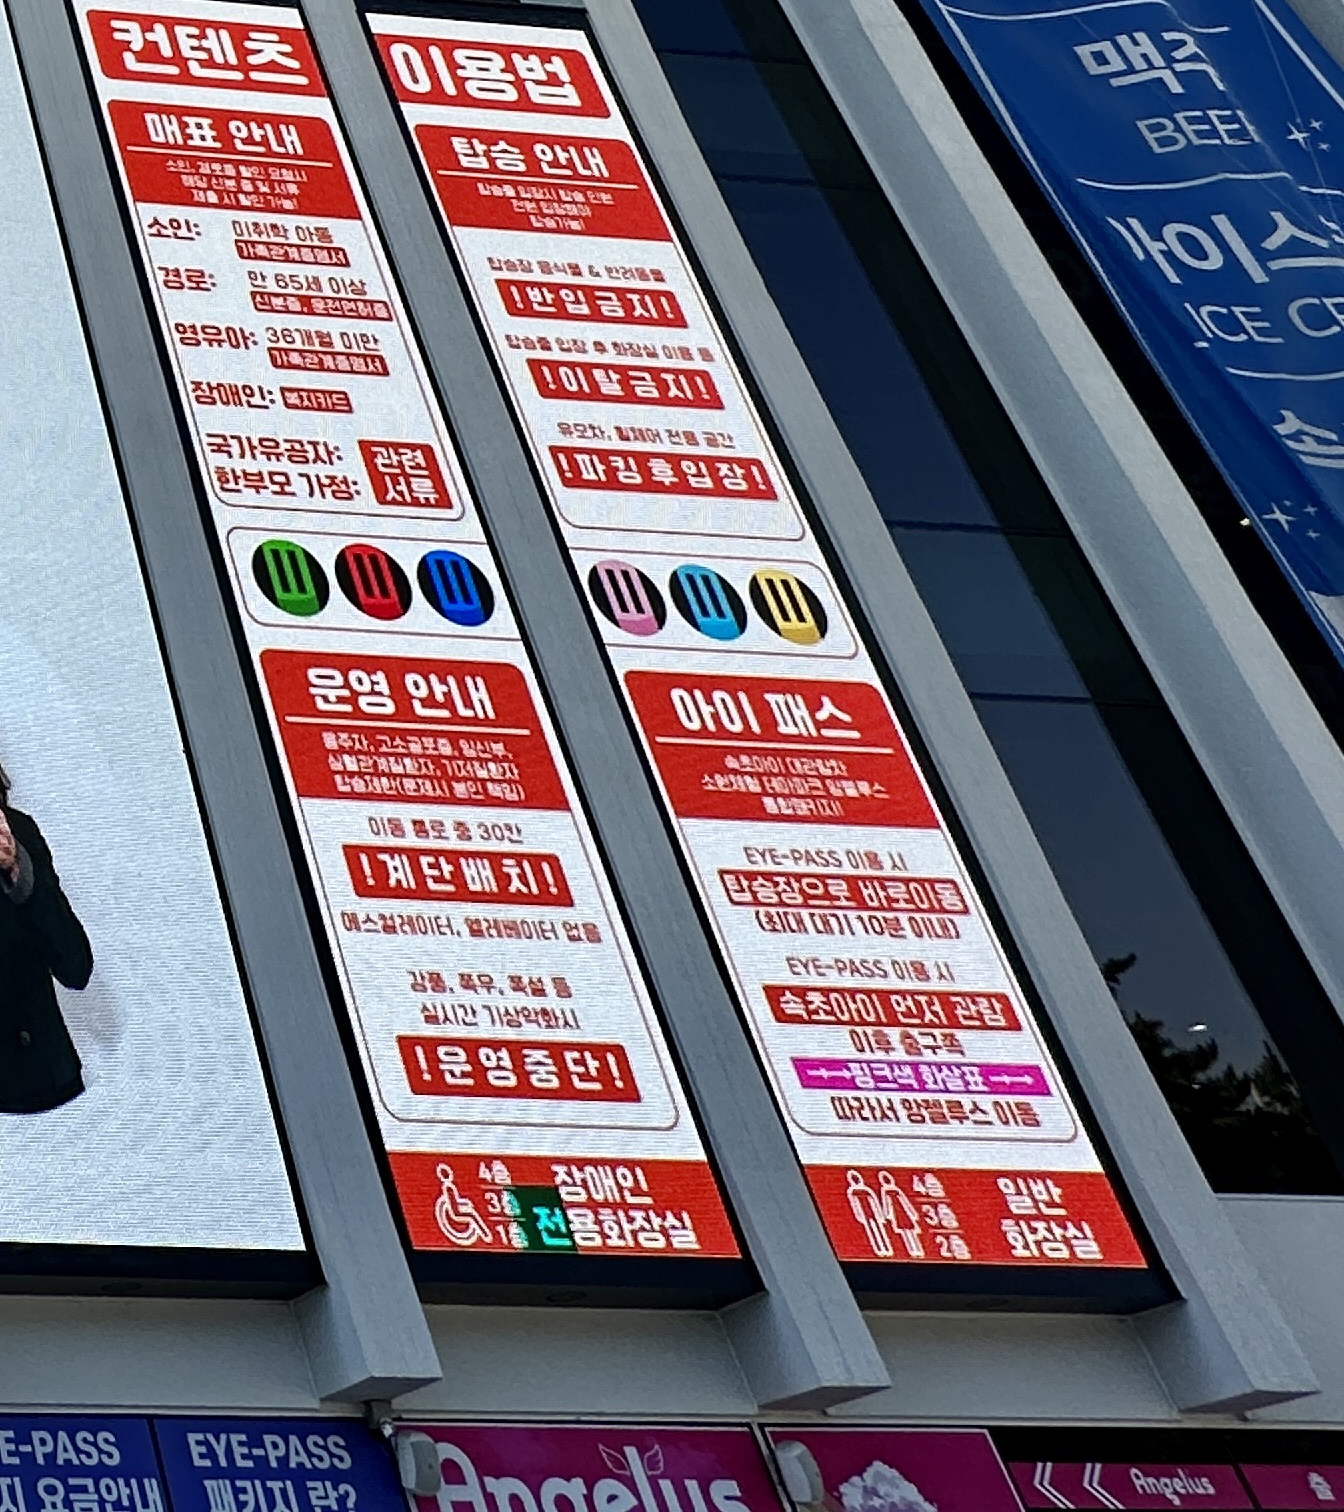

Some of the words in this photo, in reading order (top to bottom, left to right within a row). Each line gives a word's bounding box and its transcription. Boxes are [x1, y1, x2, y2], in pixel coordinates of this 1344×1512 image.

[109, 19, 310, 85] 컨텐츠
[389, 42, 582, 108] 이용법
[144, 112, 222, 148] 매표
[229, 120, 304, 155] 안내
[450, 136, 528, 172] 탑승
[533, 143, 610, 178] 안내
[148, 216, 201, 242] 소인:
[231, 219, 289, 242] 미취학
[294, 225, 335, 245] 아동
[158, 266, 217, 292] 경로:
[247, 270, 267, 290] 만
[274, 273, 323, 293] 65세
[328, 276, 368, 296] 이상
[174, 322, 259, 350] 영유아:
[264, 326, 335, 350] 36개월
[339, 331, 381, 352] 미만
[190, 380, 276, 410] 장애인:
[283, 389, 351, 412] 복지카드
[206, 433, 343, 466] 국가유공자:
[371, 444, 427, 474] 관련
[214, 466, 297, 497] 한부모
[298, 471, 362, 501] 가정:
[384, 474, 441, 505] 서류
[306, 667, 396, 715] 운영
[404, 672, 496, 720] 안내
[670, 687, 761, 735] 아이
[763, 691, 862, 738] 패스
[743, 845, 843, 870] EYE-PASS
[890, 850, 908, 872] 시
[721, 873, 857, 908] 탑승장으로
[860, 878, 966, 912] 바로이동
[811, 912, 856, 937] 대기
[858, 914, 907, 940] 10분
[786, 955, 888, 980] EYE-PASS
[935, 961, 956, 984] 시
[420, 1001, 480, 1027] 실시간
[481, 1003, 583, 1030] 기상악화시
[779, 988, 887, 1024] 속초아이
[890, 991, 947, 1025] 먼저
[954, 992, 1009, 1027] 관람
[848, 1028, 896, 1056] 이후
[847, 1062, 920, 1089] 핑크색
[918, 1063, 989, 1093] 화살표
[830, 1095, 901, 1123] 따라서
[991, 1100, 1041, 1128] 이동
[551, 1162, 654, 1205] 장애인
[996, 1176, 1069, 1216] 일반
[532, 1205, 701, 1250] 전용화장실
[1001, 1219, 1106, 1261] 화장실
[186, 1432, 353, 1470] EYE-PASS
[1129, 1466, 1216, 1506] Angelus
